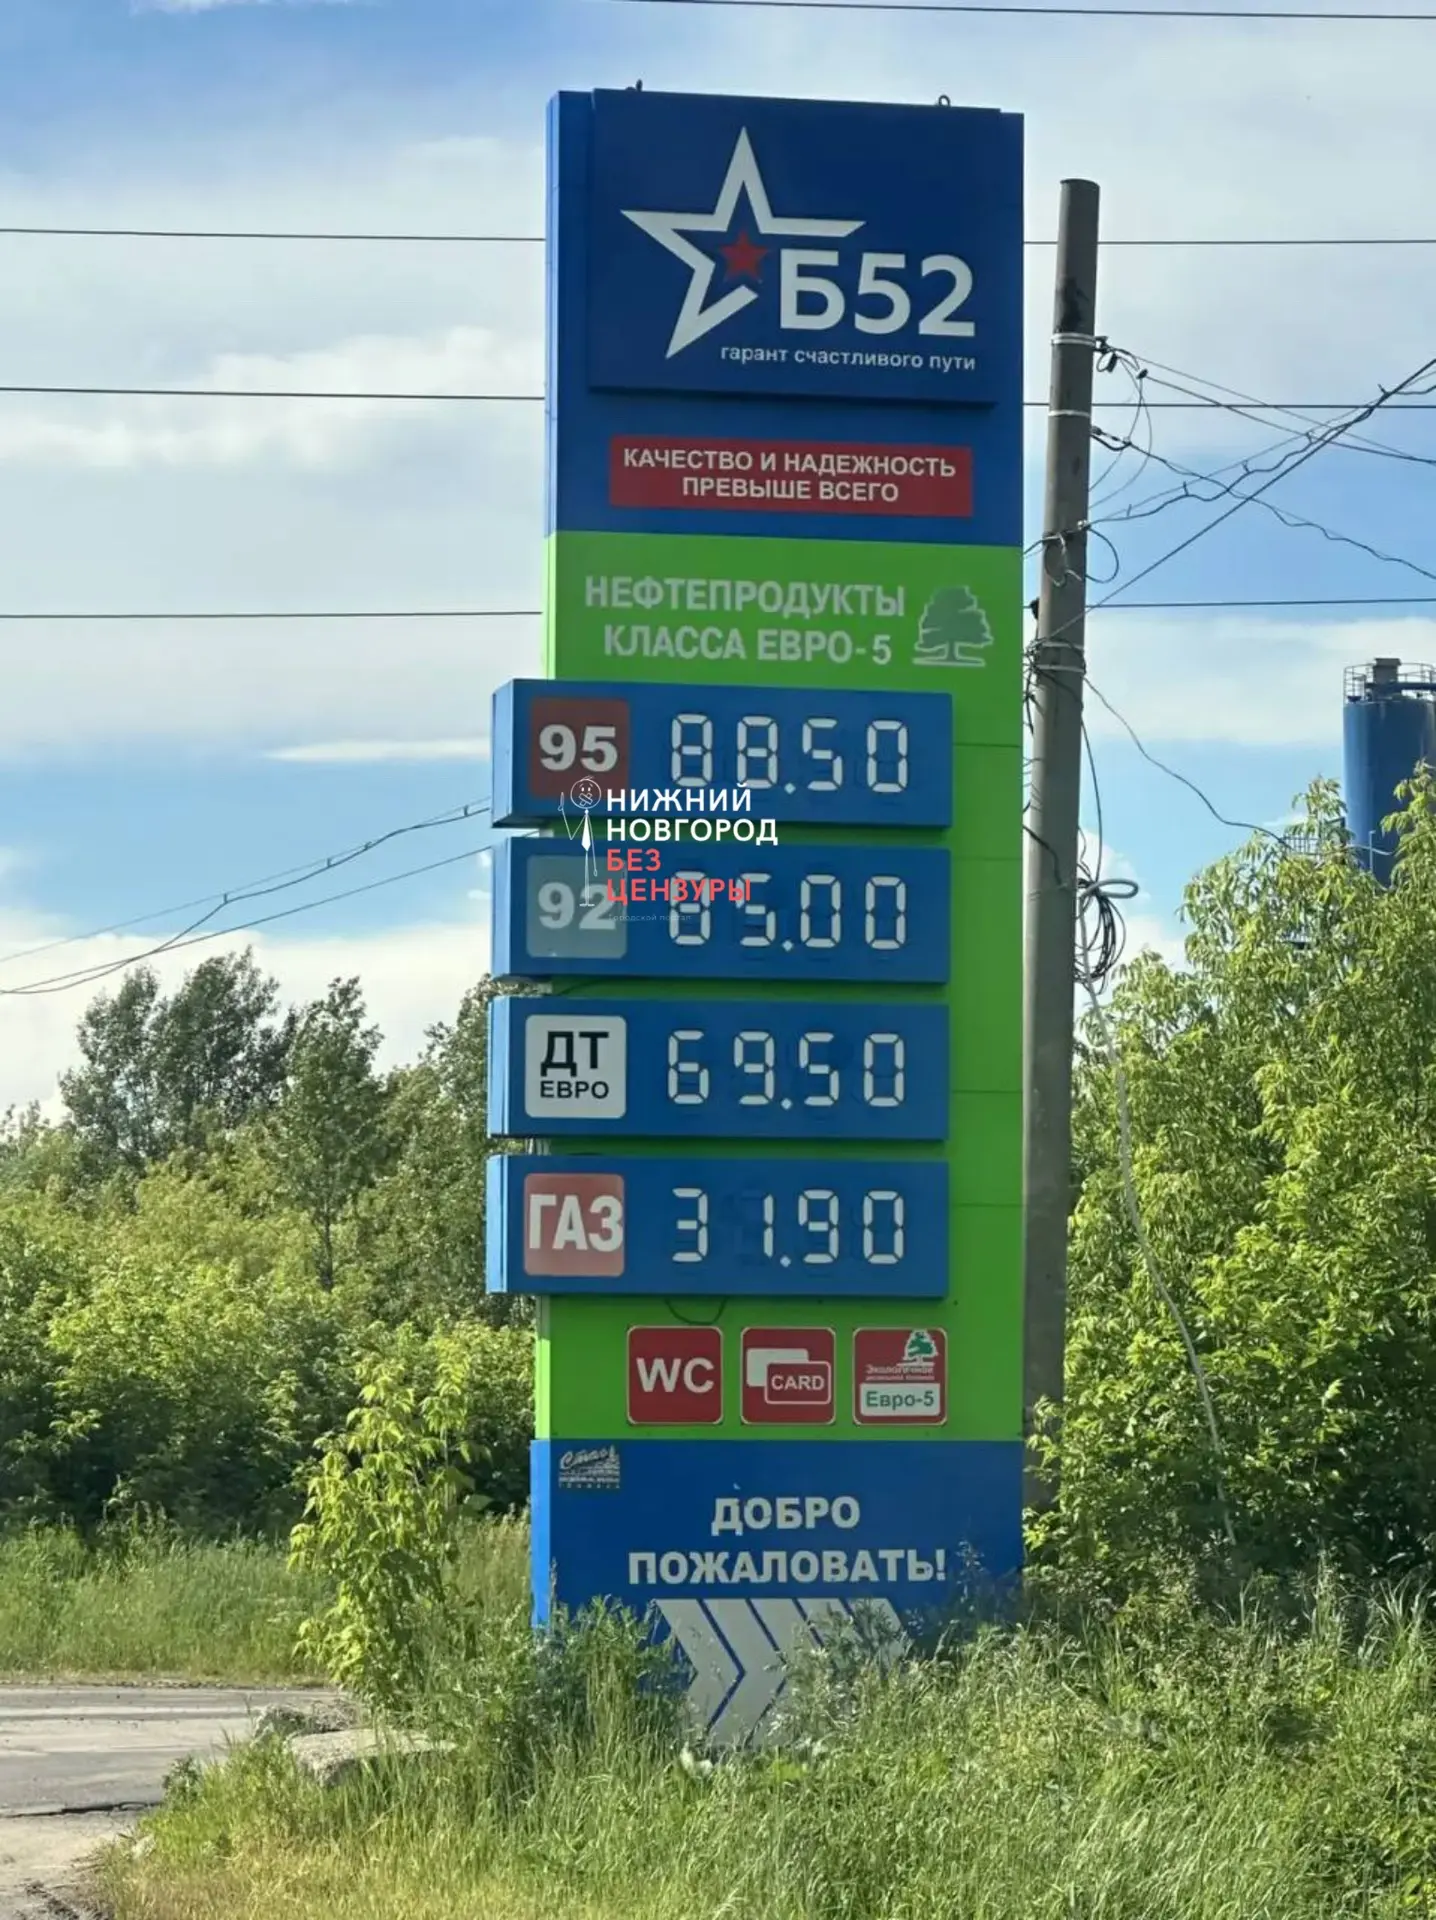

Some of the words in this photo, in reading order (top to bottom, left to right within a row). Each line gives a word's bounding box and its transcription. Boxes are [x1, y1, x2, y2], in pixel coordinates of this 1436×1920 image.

[780, 248, 976, 337] Б52
[721, 346, 788, 365] гарант
[794, 349, 924, 369] счастливого
[929, 355, 976, 373] пути
[623, 447, 753, 471] КАЧЕСТВО
[761, 452, 777, 473] И
[784, 453, 957, 478] НАДЕЖНОСТЬ
[682, 476, 811, 500] ПРЕВЫШЕ
[819, 480, 899, 502] ВСЕГО
[584, 576, 905, 619] НЕФТЕПРОДУКТЫ
[603, 624, 747, 661] КЛАССА
[538, 724, 618, 773] 95
[671, 713, 909, 794] 88.50
[537, 882, 617, 930] 92
[668, 870, 907, 951] 85.00
[540, 1031, 610, 1077] ДТ
[667, 1030, 905, 1110] 69.50
[540, 1081, 610, 1100] ЕВРО
[528, 1193, 624, 1253] ГАЗ
[671, 1187, 905, 1268] 31.90
[636, 1357, 714, 1394] WC
[771, 1375, 825, 1391] CARD
[865, 1389, 935, 1411] Евро-5
[710, 1496, 861, 1537] ДОБРО
[628, 1548, 946, 1585] ПОЖАЛОВАТЬ!
